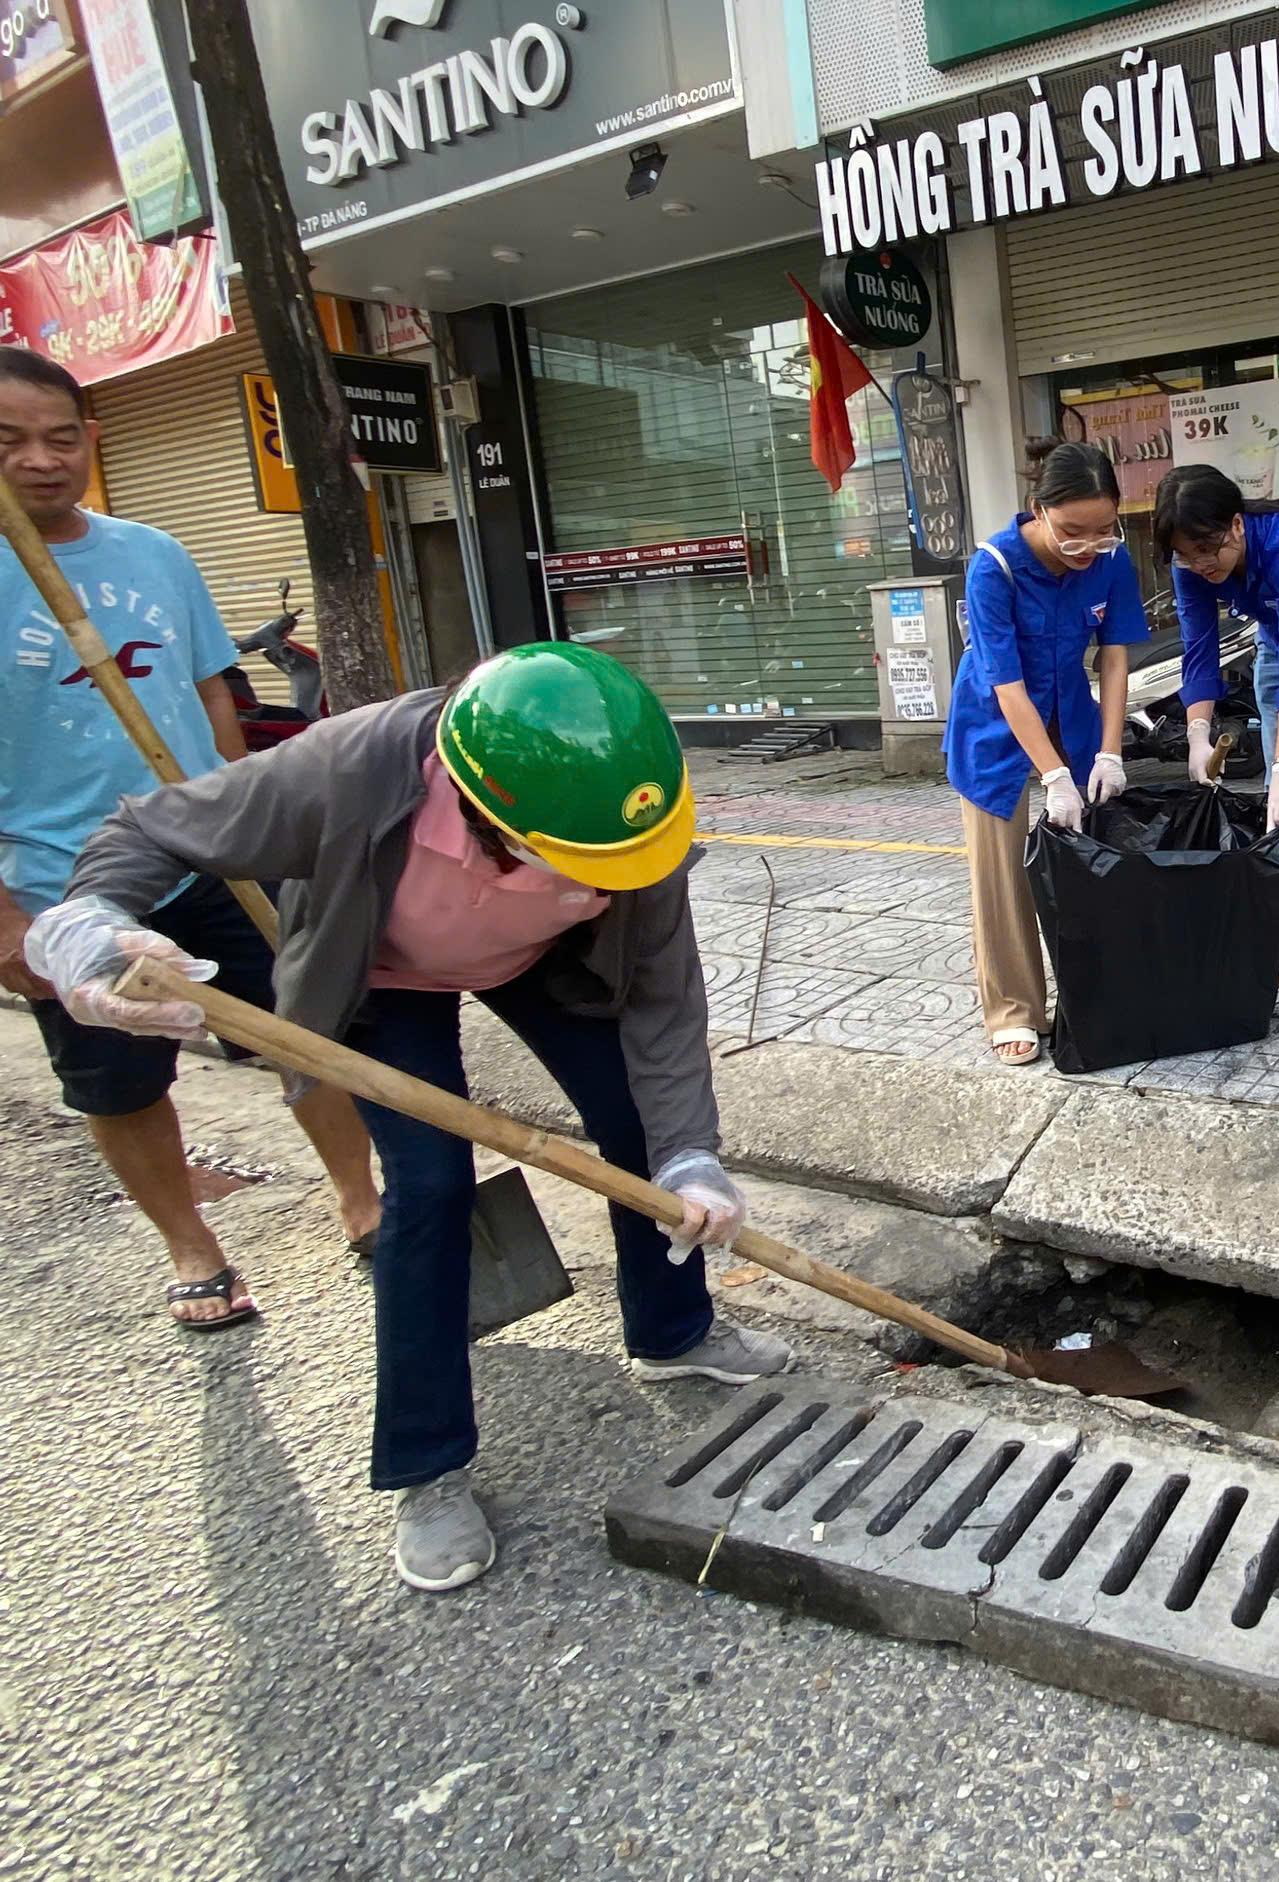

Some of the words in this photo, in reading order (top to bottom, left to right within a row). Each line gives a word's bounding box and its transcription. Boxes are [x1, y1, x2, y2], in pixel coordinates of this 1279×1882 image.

[302, 22, 566, 186] SANTINO
[595, 78, 736, 135] www.santino.com.v
[814, 118, 951, 256] HỒNG
[958, 76, 1066, 223] TRÀ
[1081, 46, 1201, 196] SỮA
[854, 272, 888, 298] TRÀ
[1208, 401, 1240, 413] CHEESE
[351, 415, 418, 444] NTINO
[1184, 415, 1229, 440] 39K
[477, 442, 503, 466] 191
